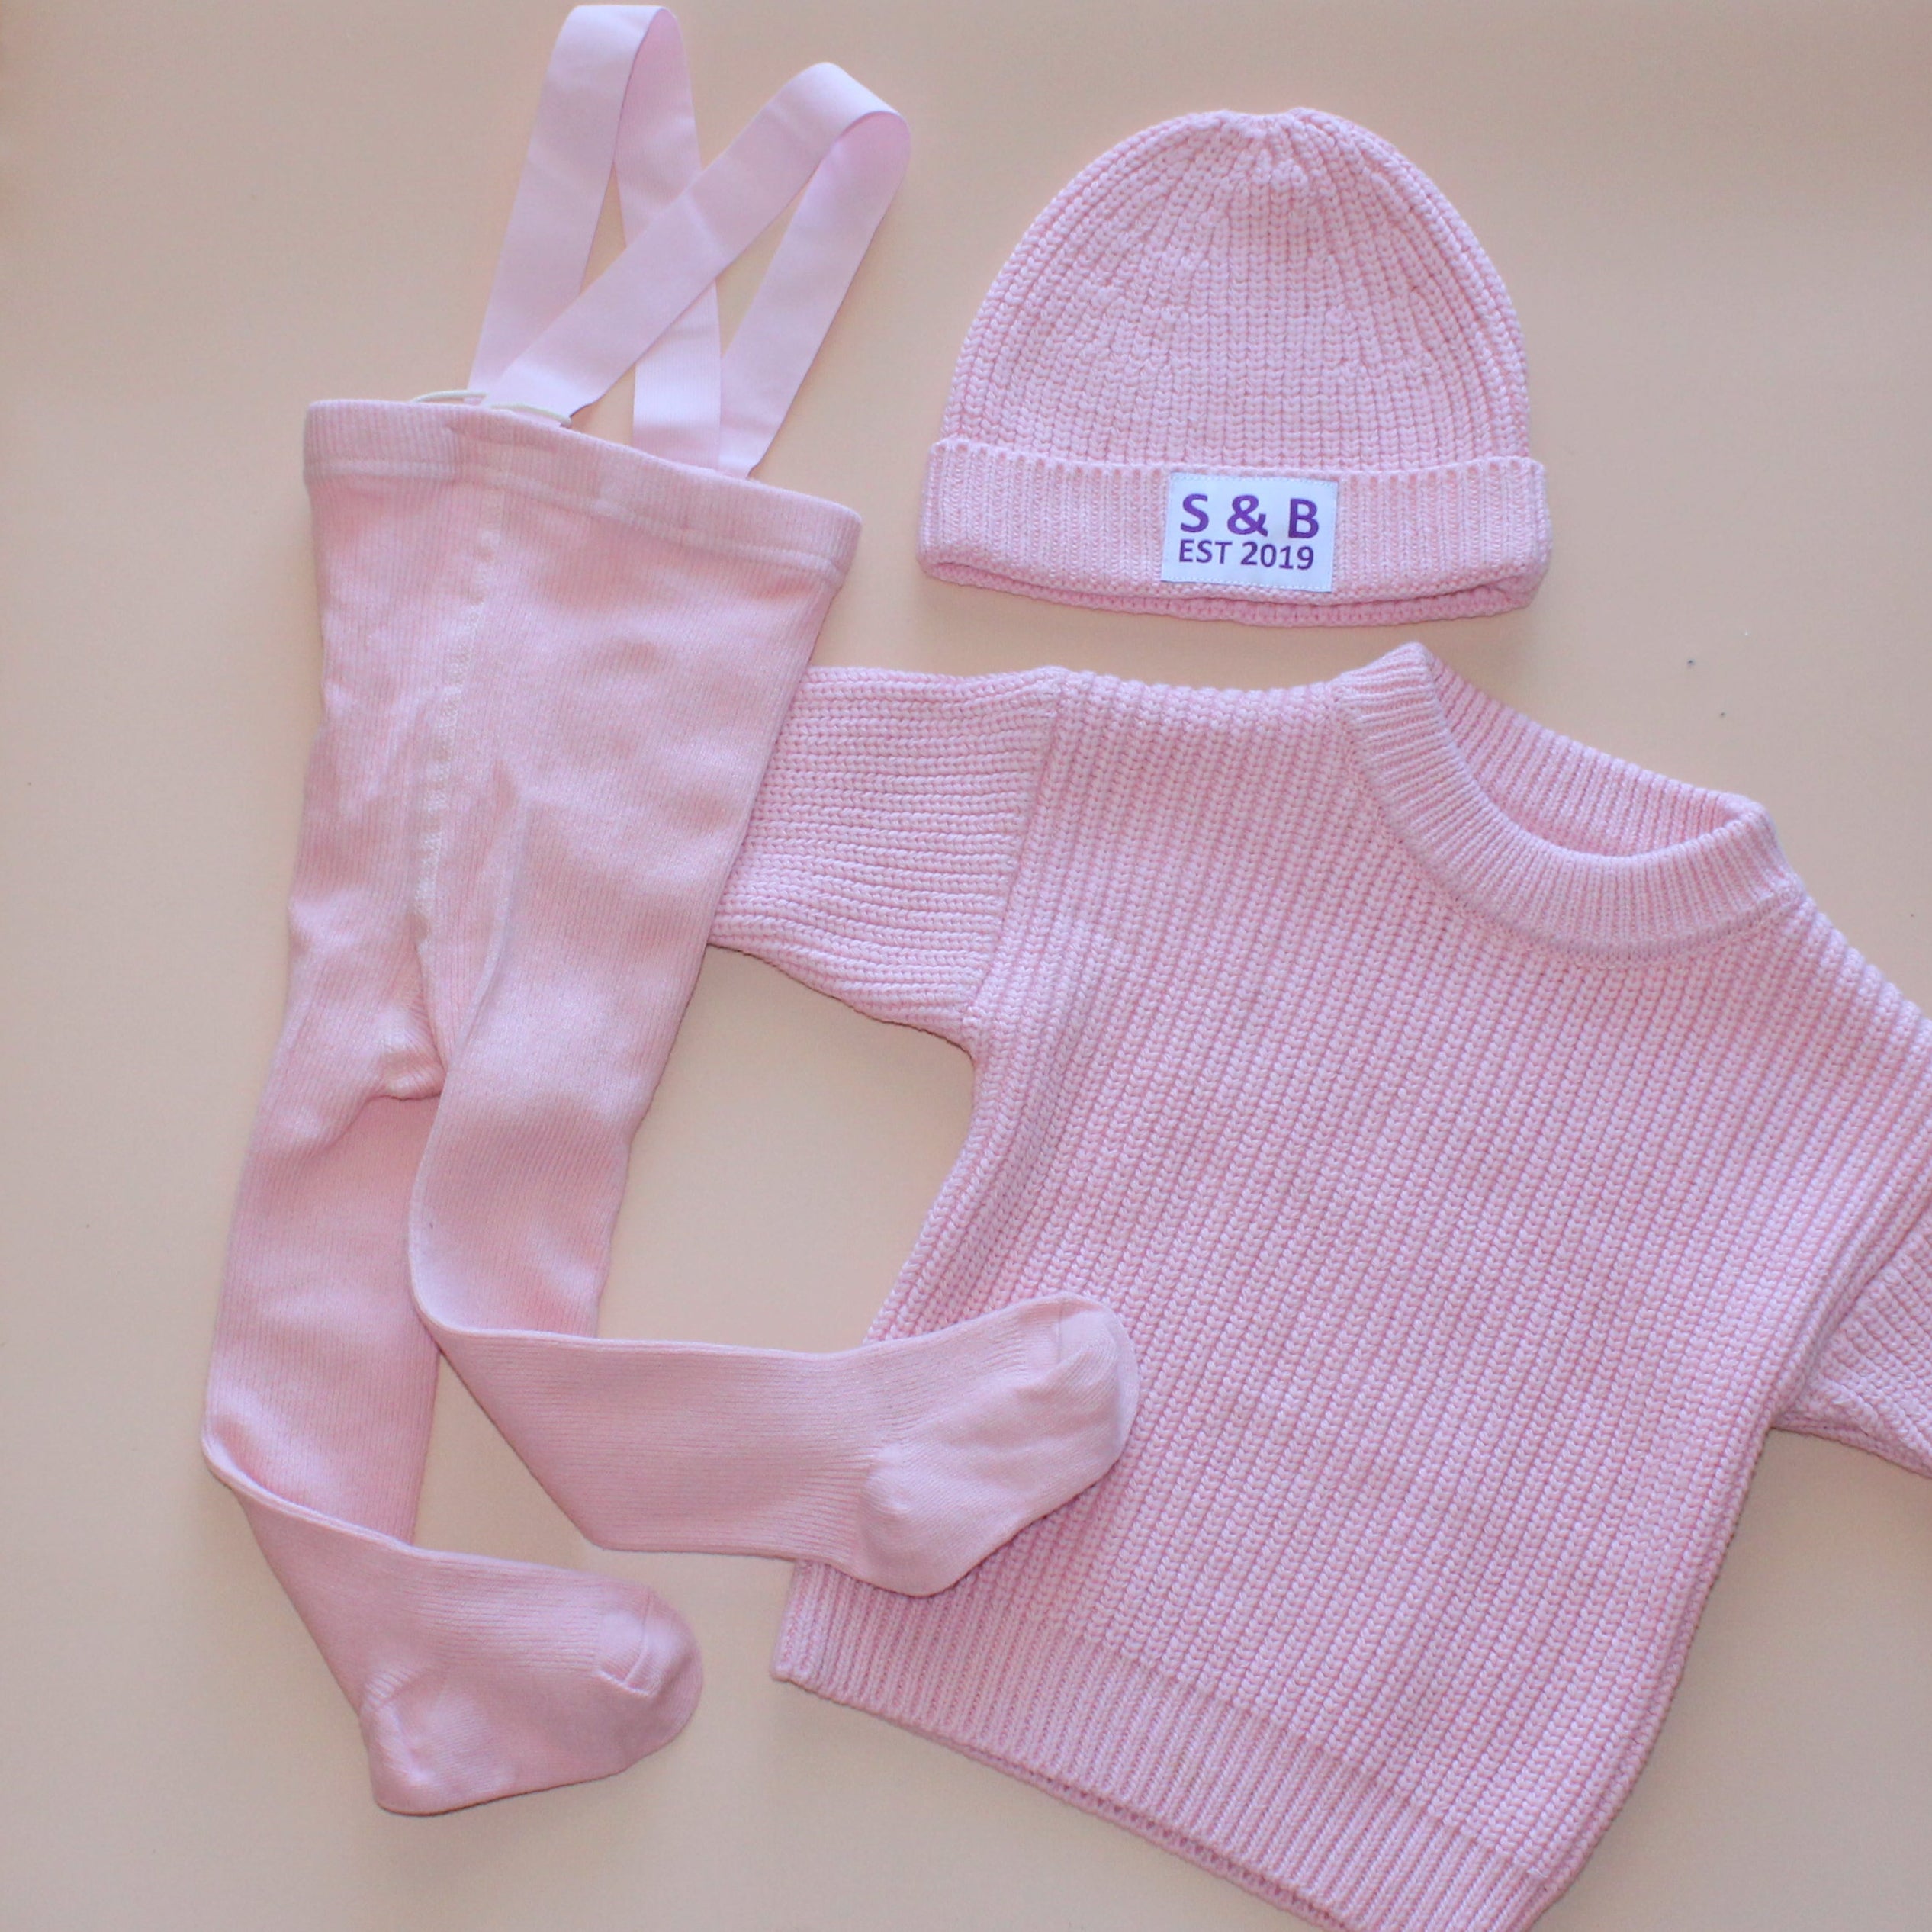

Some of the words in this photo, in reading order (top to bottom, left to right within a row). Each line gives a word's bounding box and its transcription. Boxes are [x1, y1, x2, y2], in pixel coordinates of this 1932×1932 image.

[1180, 493, 1210, 533] S
[1226, 494, 1268, 538] &
[1287, 498, 1320, 539] B
[1179, 539, 1233, 564] EST
[1240, 541, 1315, 571] 2019
